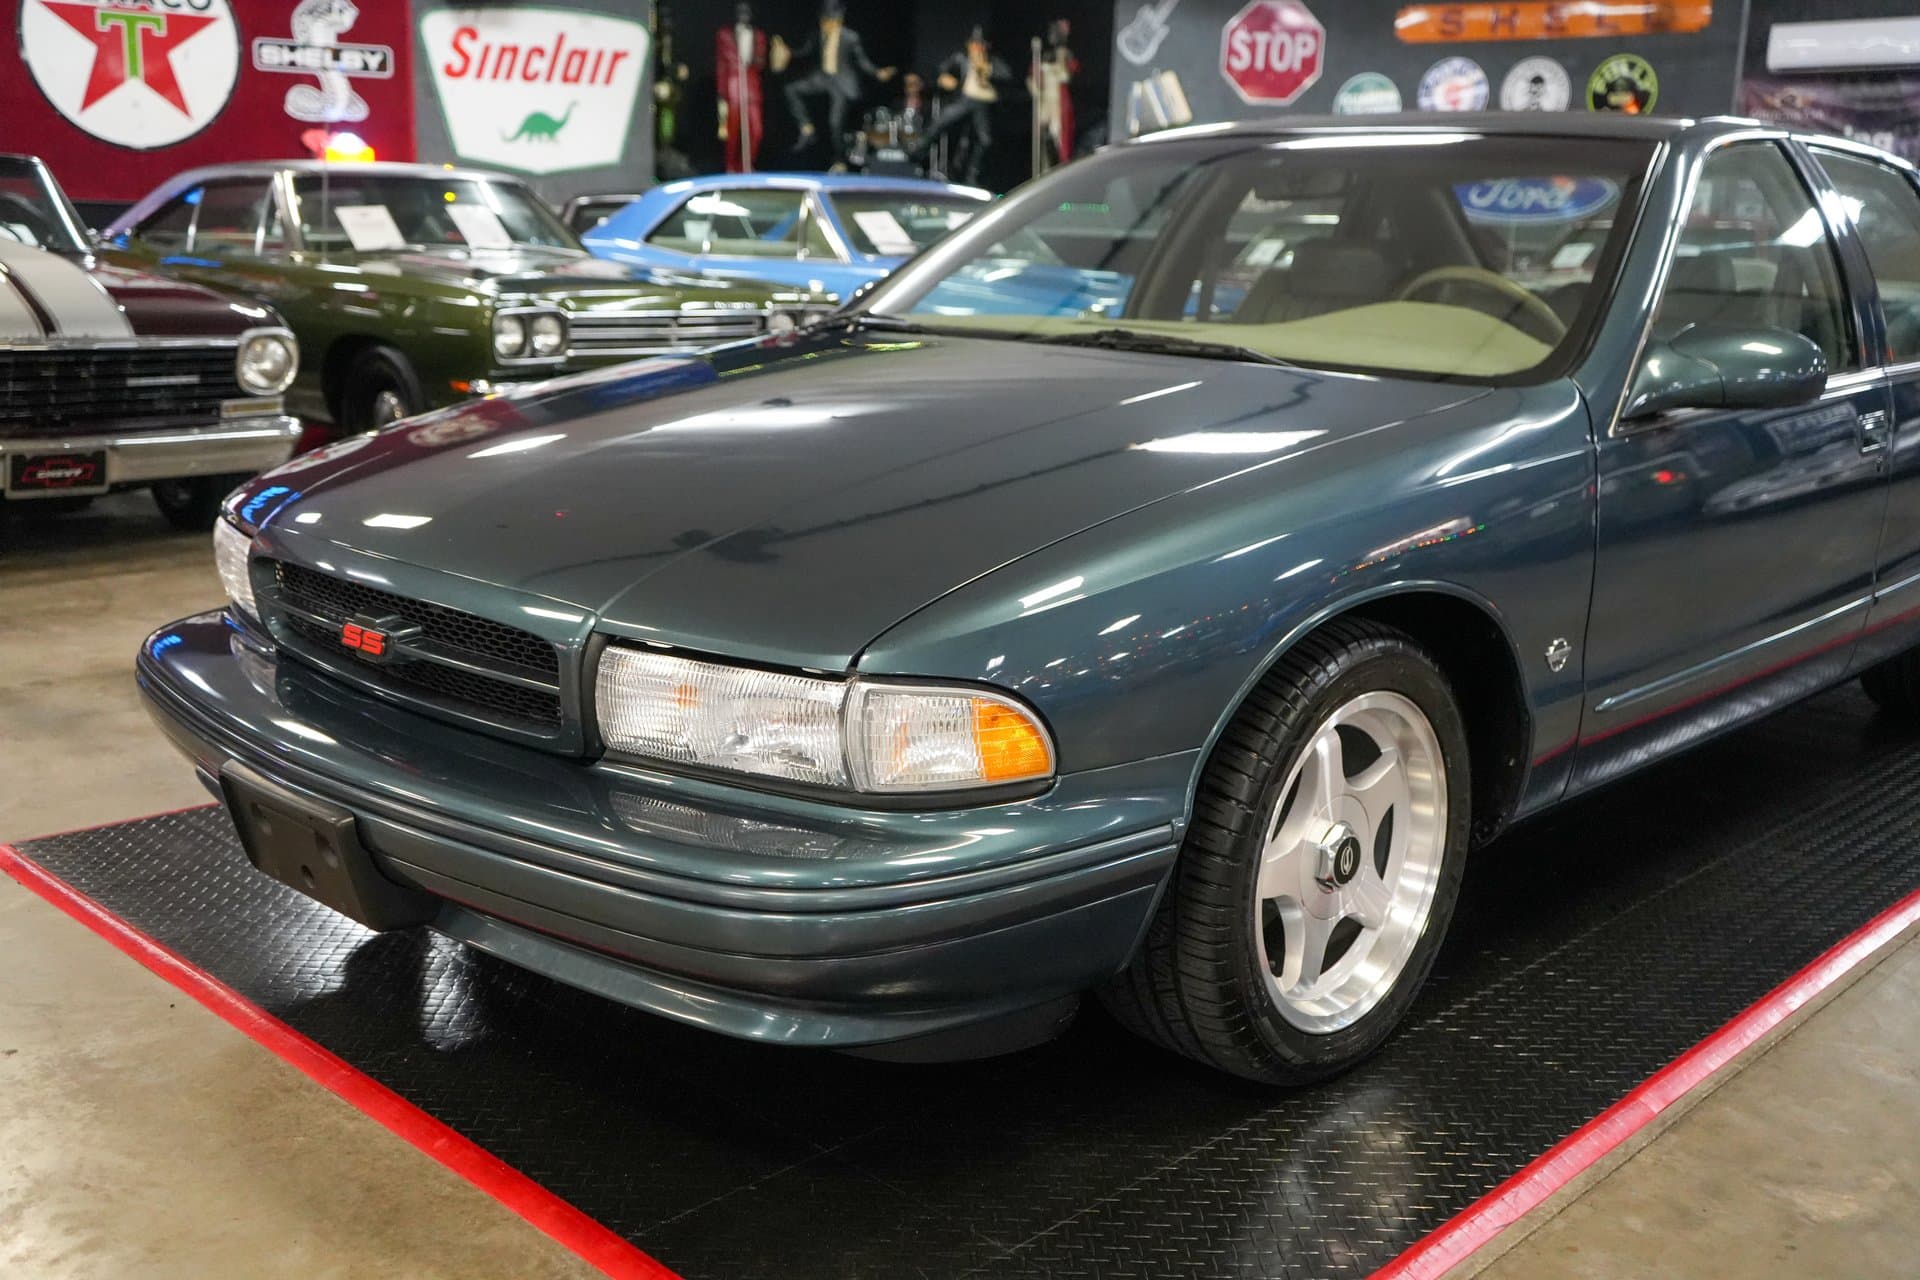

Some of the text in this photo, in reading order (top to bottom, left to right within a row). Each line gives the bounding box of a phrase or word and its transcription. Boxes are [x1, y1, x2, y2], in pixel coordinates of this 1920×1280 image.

[259, 44, 386, 71] SHELBY
[444, 24, 629, 85] Sinclair
[1229, 30, 1316, 72] STOP
[341, 623, 384, 656] SS
